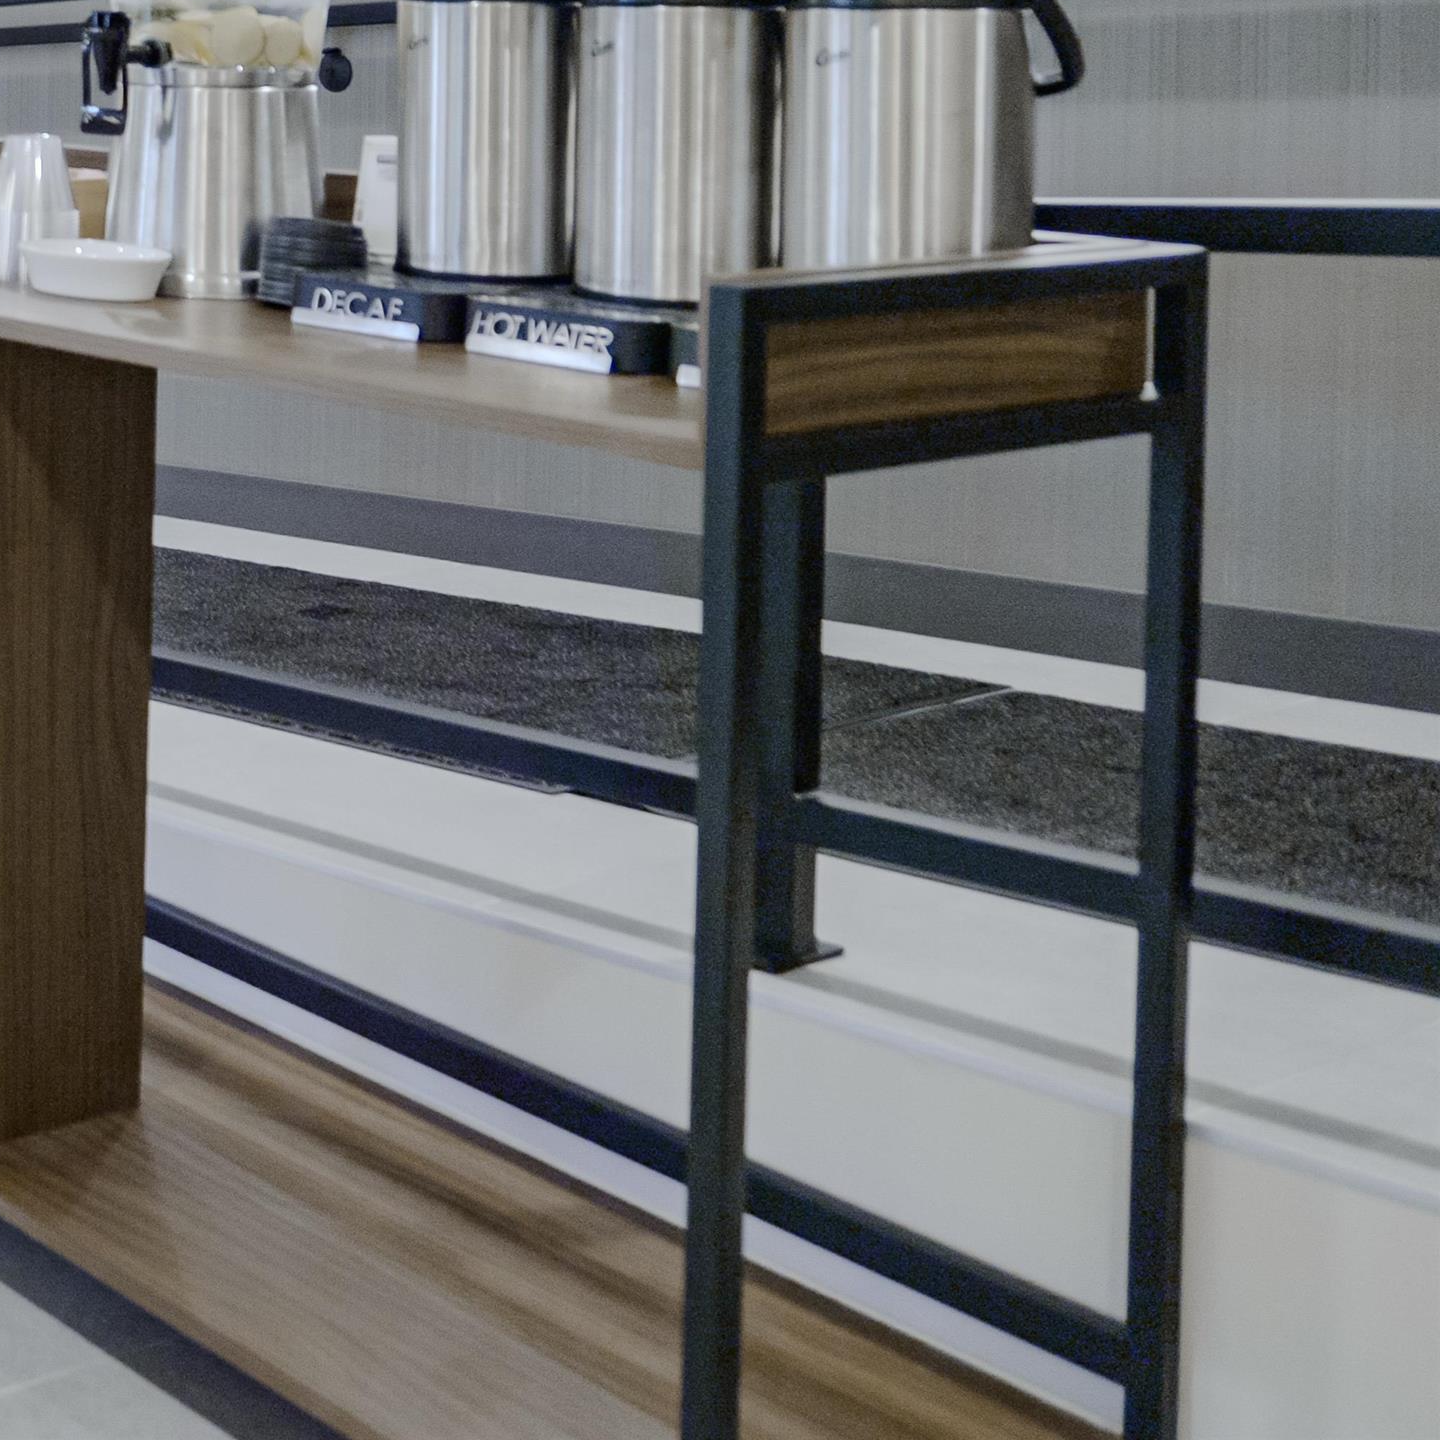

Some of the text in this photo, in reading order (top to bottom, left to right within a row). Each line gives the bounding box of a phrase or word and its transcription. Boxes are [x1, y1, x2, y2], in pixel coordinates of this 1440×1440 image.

[311, 286, 405, 321] DECAF
[471, 309, 615, 354] HOT WATER
